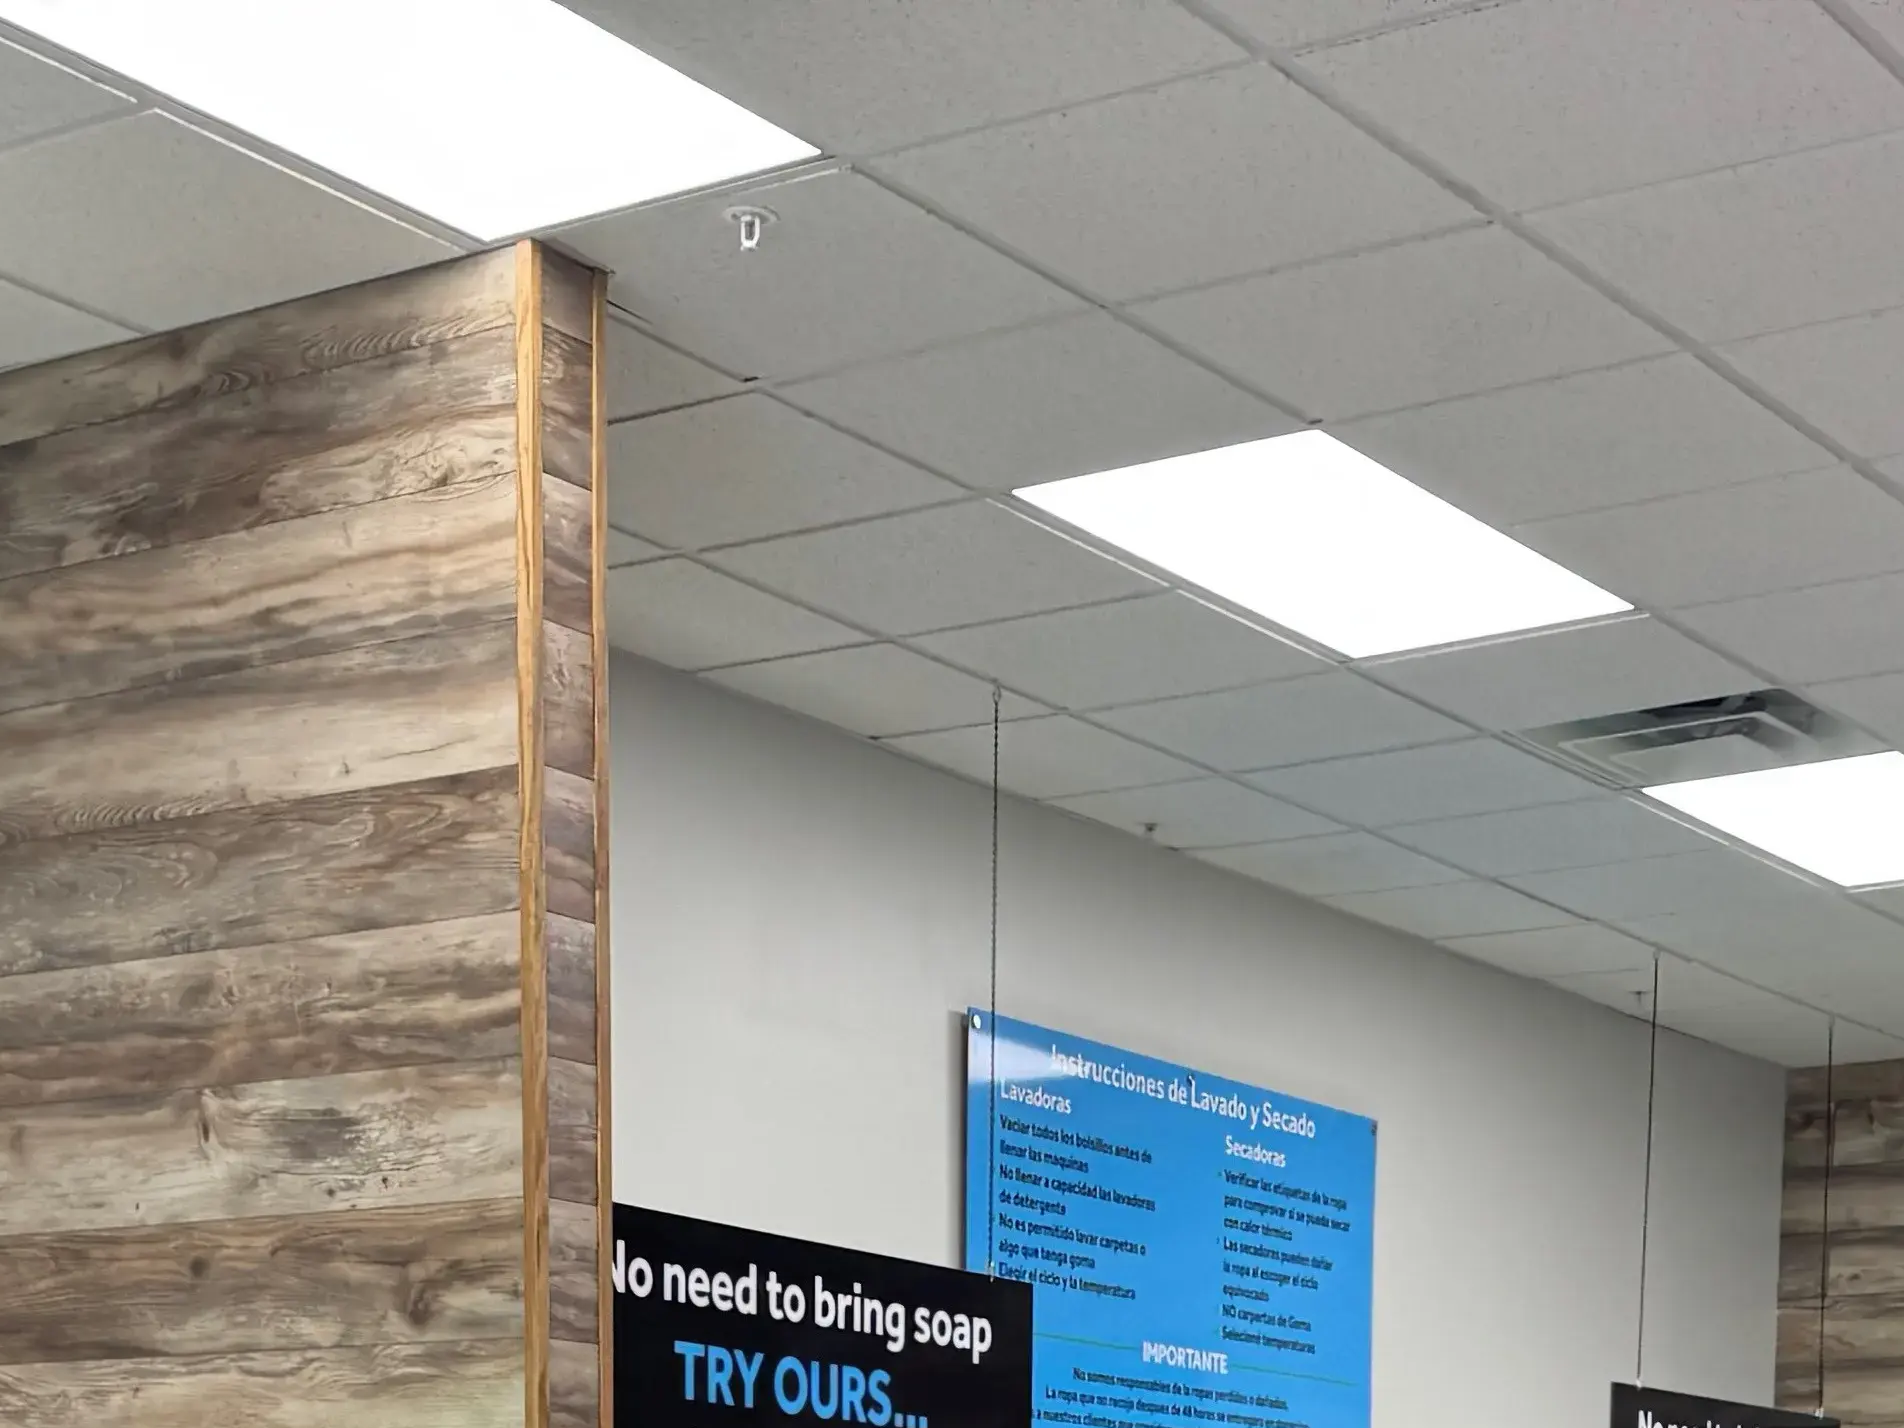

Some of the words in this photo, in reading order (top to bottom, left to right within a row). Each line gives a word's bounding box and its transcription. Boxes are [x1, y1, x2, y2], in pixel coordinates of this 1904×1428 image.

[1000, 1079, 1072, 1114] Lavadoras
[1051, 1044, 1164, 1100] Instrucciones
[1169, 1078, 1186, 1105] de
[1191, 1080, 1246, 1120] Lavado
[1250, 1105, 1259, 1129] y
[1264, 1104, 1315, 1138] Secado
[1060, 1129, 1074, 1145] los
[1141, 1148, 1152, 1164] de
[1225, 1135, 1286, 1167] Secadoras
[1000, 1164, 1013, 1180] No
[999, 1189, 1011, 1204] de
[999, 1213, 1013, 1230] No
[1015, 1219, 1026, 1232] es
[1140, 1244, 1145, 1256] o
[1062, 1276, 1067, 1291] y
[663, 1263, 757, 1316] need
[766, 1271, 806, 1323] to
[815, 1276, 905, 1353] bring
[914, 1307, 991, 1364] soap
[674, 1340, 764, 1408] TRY
[1142, 1340, 1229, 1374] IMPORTANTE
